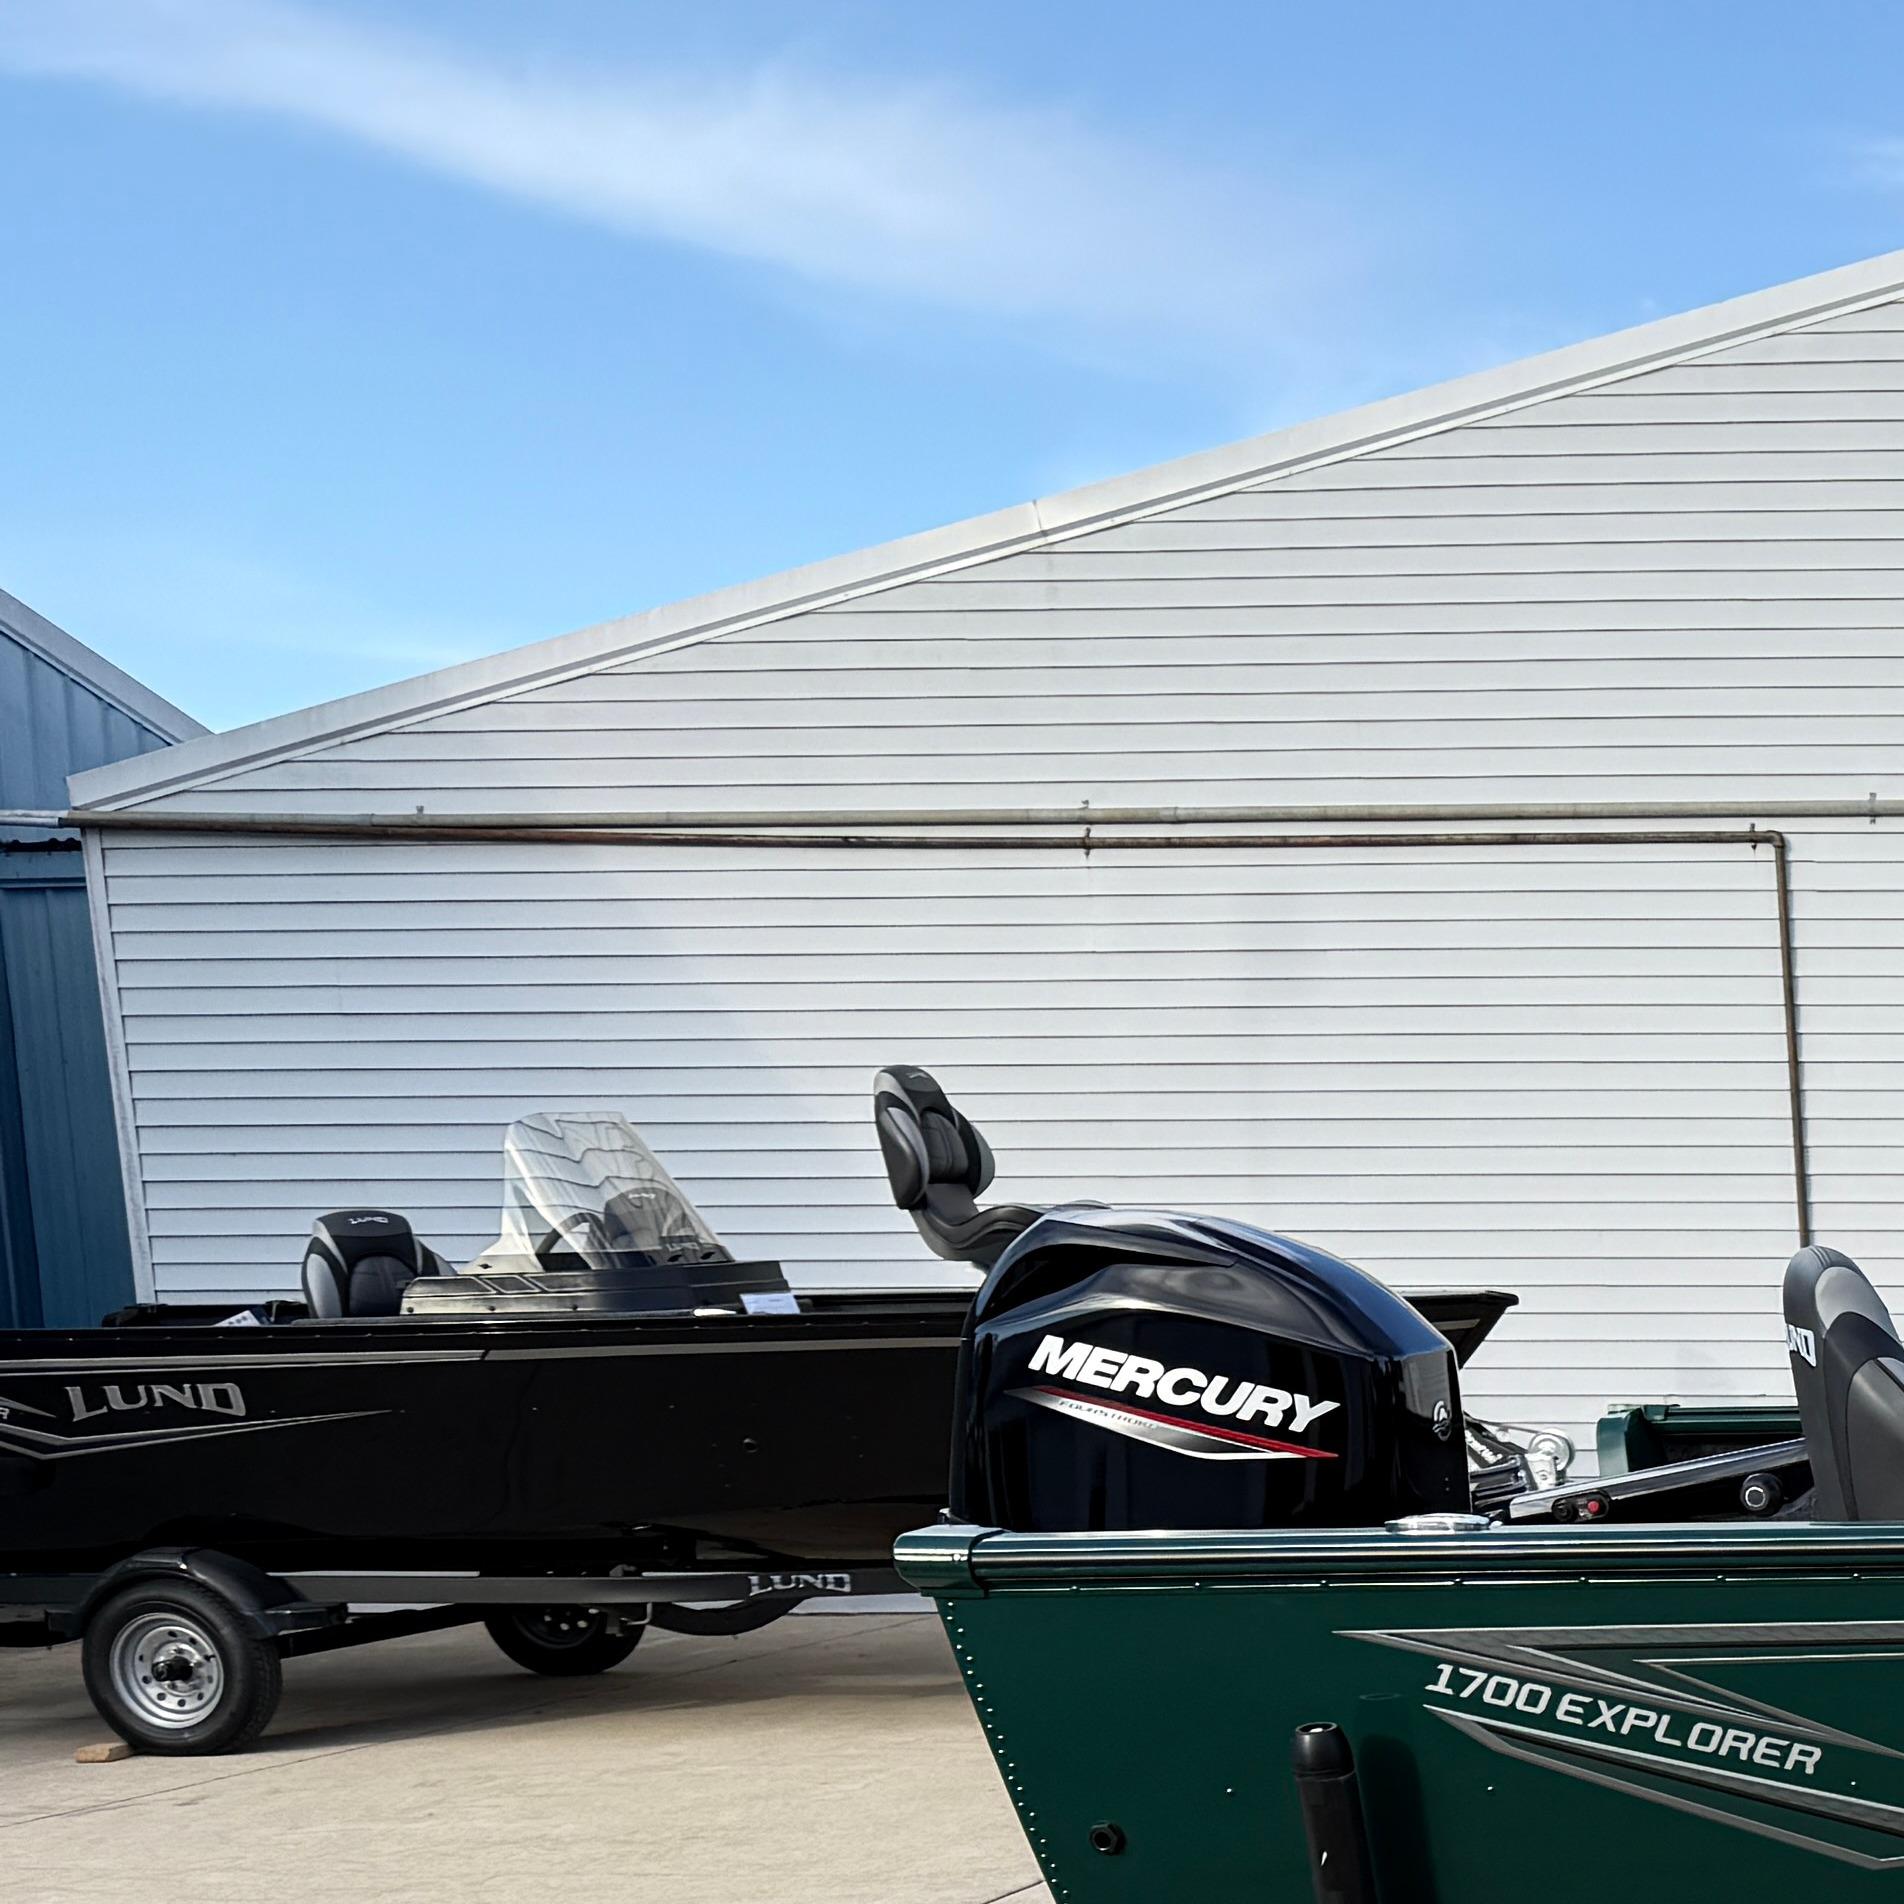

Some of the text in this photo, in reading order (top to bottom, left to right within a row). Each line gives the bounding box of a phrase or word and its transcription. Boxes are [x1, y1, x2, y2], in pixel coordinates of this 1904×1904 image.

[64, 1382, 247, 1422] LUND
[1027, 1334, 1341, 1432] MERCURY
[747, 1573, 852, 1597] LUND
[1424, 1663, 1822, 1774] 1700 EXPLORER
